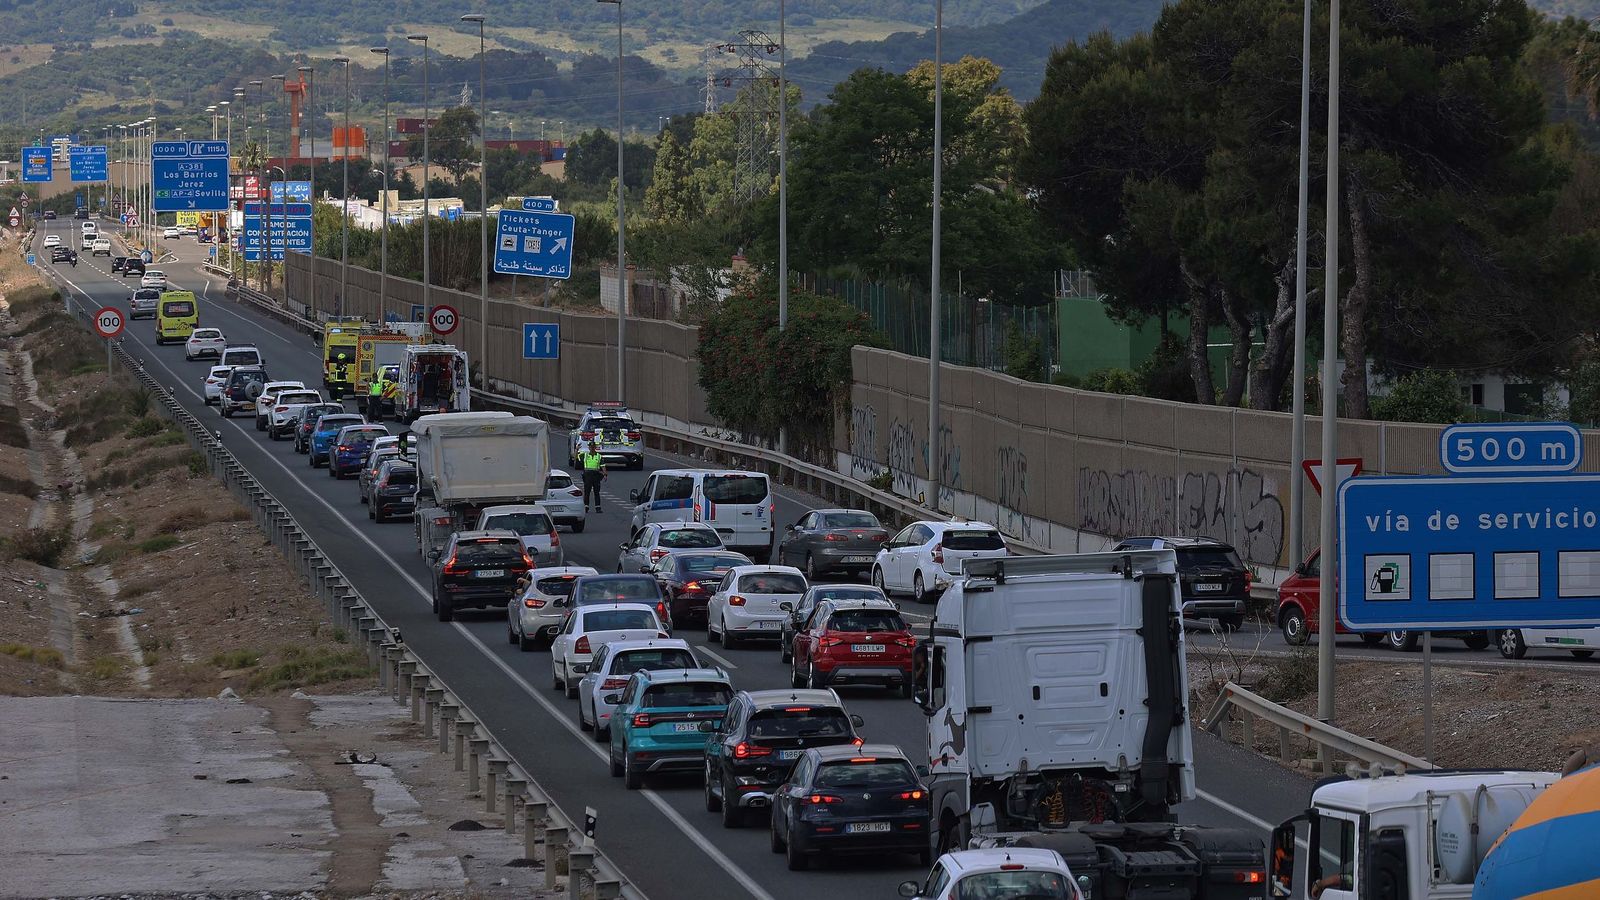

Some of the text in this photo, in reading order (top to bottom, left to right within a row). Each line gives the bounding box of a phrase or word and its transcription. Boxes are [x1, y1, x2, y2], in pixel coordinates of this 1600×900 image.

[178, 180, 204, 188] Jerez
[503, 214, 540, 225] Tickets
[501, 224, 562, 238] Ceuta-Tanger
[99, 316, 120, 327] 100
[433, 314, 454, 325] 100
[1457, 437, 1566, 461] 500 m
[1366, 507, 1597, 532] vía de servicio
[677, 723, 694, 731] 2515
[853, 822, 889, 832] 1823 HGT
